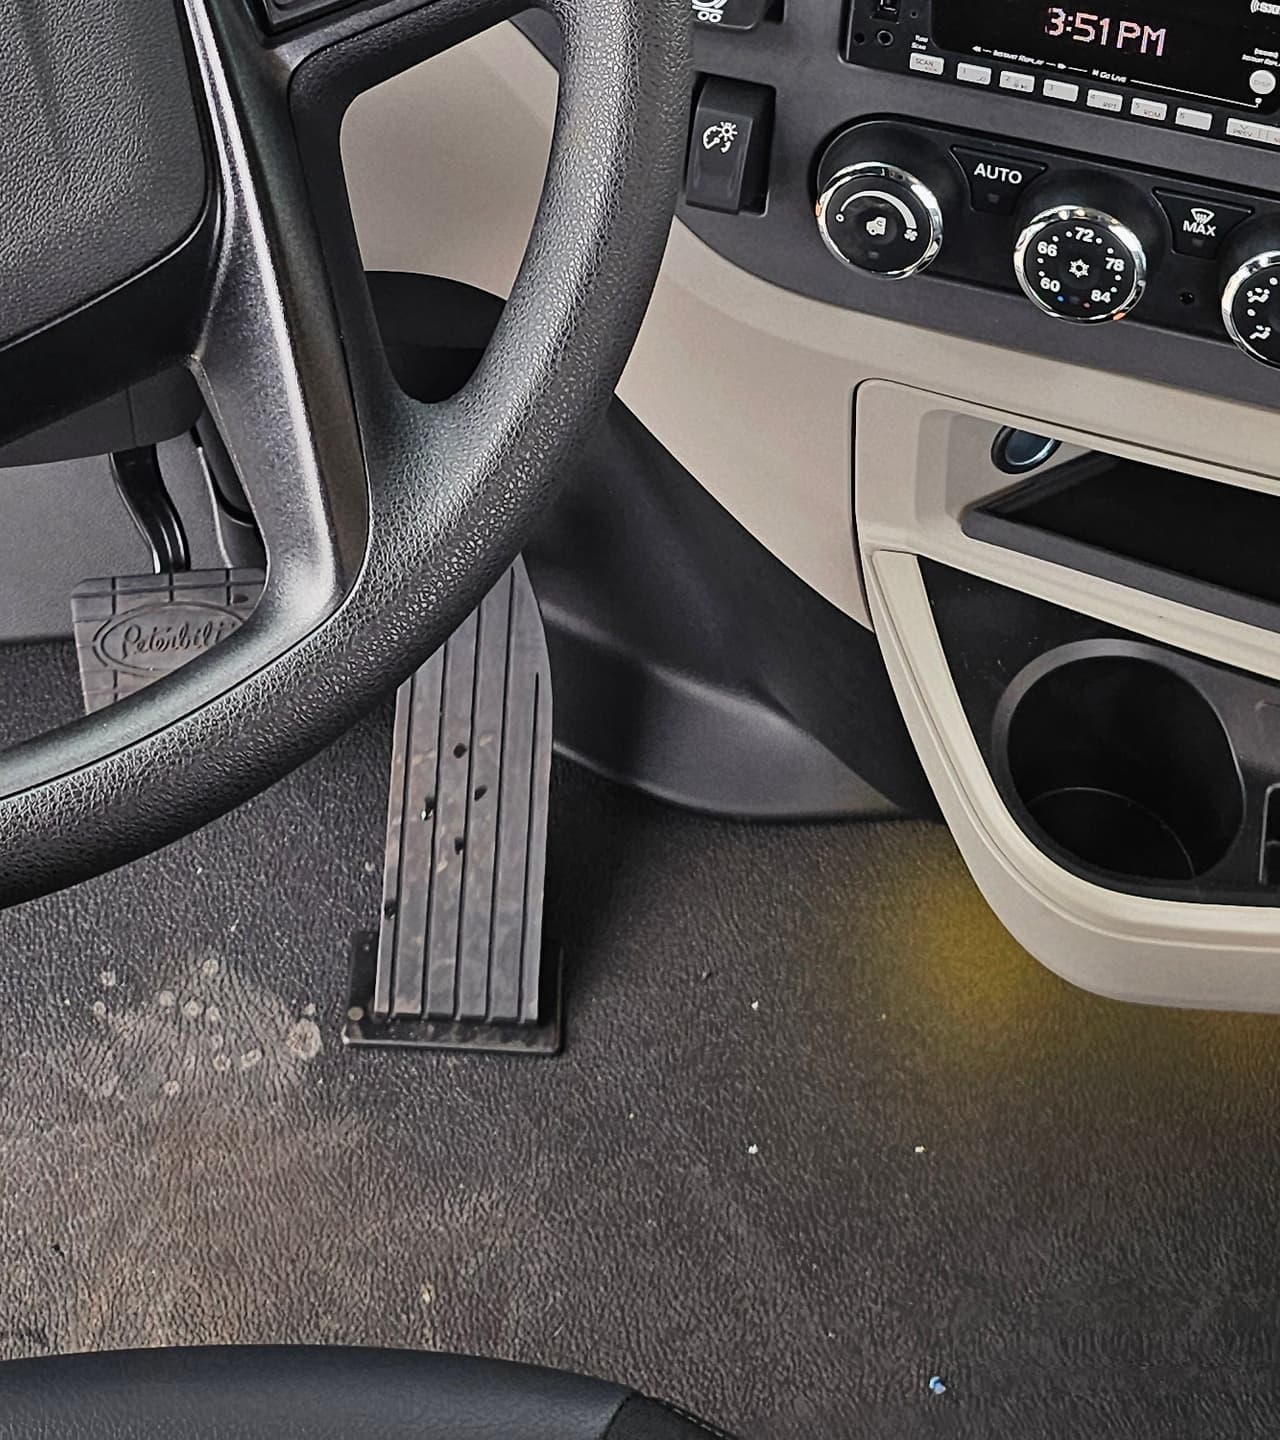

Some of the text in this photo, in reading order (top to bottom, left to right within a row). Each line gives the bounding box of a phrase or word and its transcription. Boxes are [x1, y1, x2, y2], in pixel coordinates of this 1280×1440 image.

[973, 163, 1023, 185] AUTO
[1073, 226, 1094, 243] 72
[1183, 220, 1217, 237] MAX
[1037, 241, 1058, 257] 66
[1105, 257, 1125, 272] 78
[1040, 277, 1061, 293] 60
[1091, 290, 1112, 304] 84
